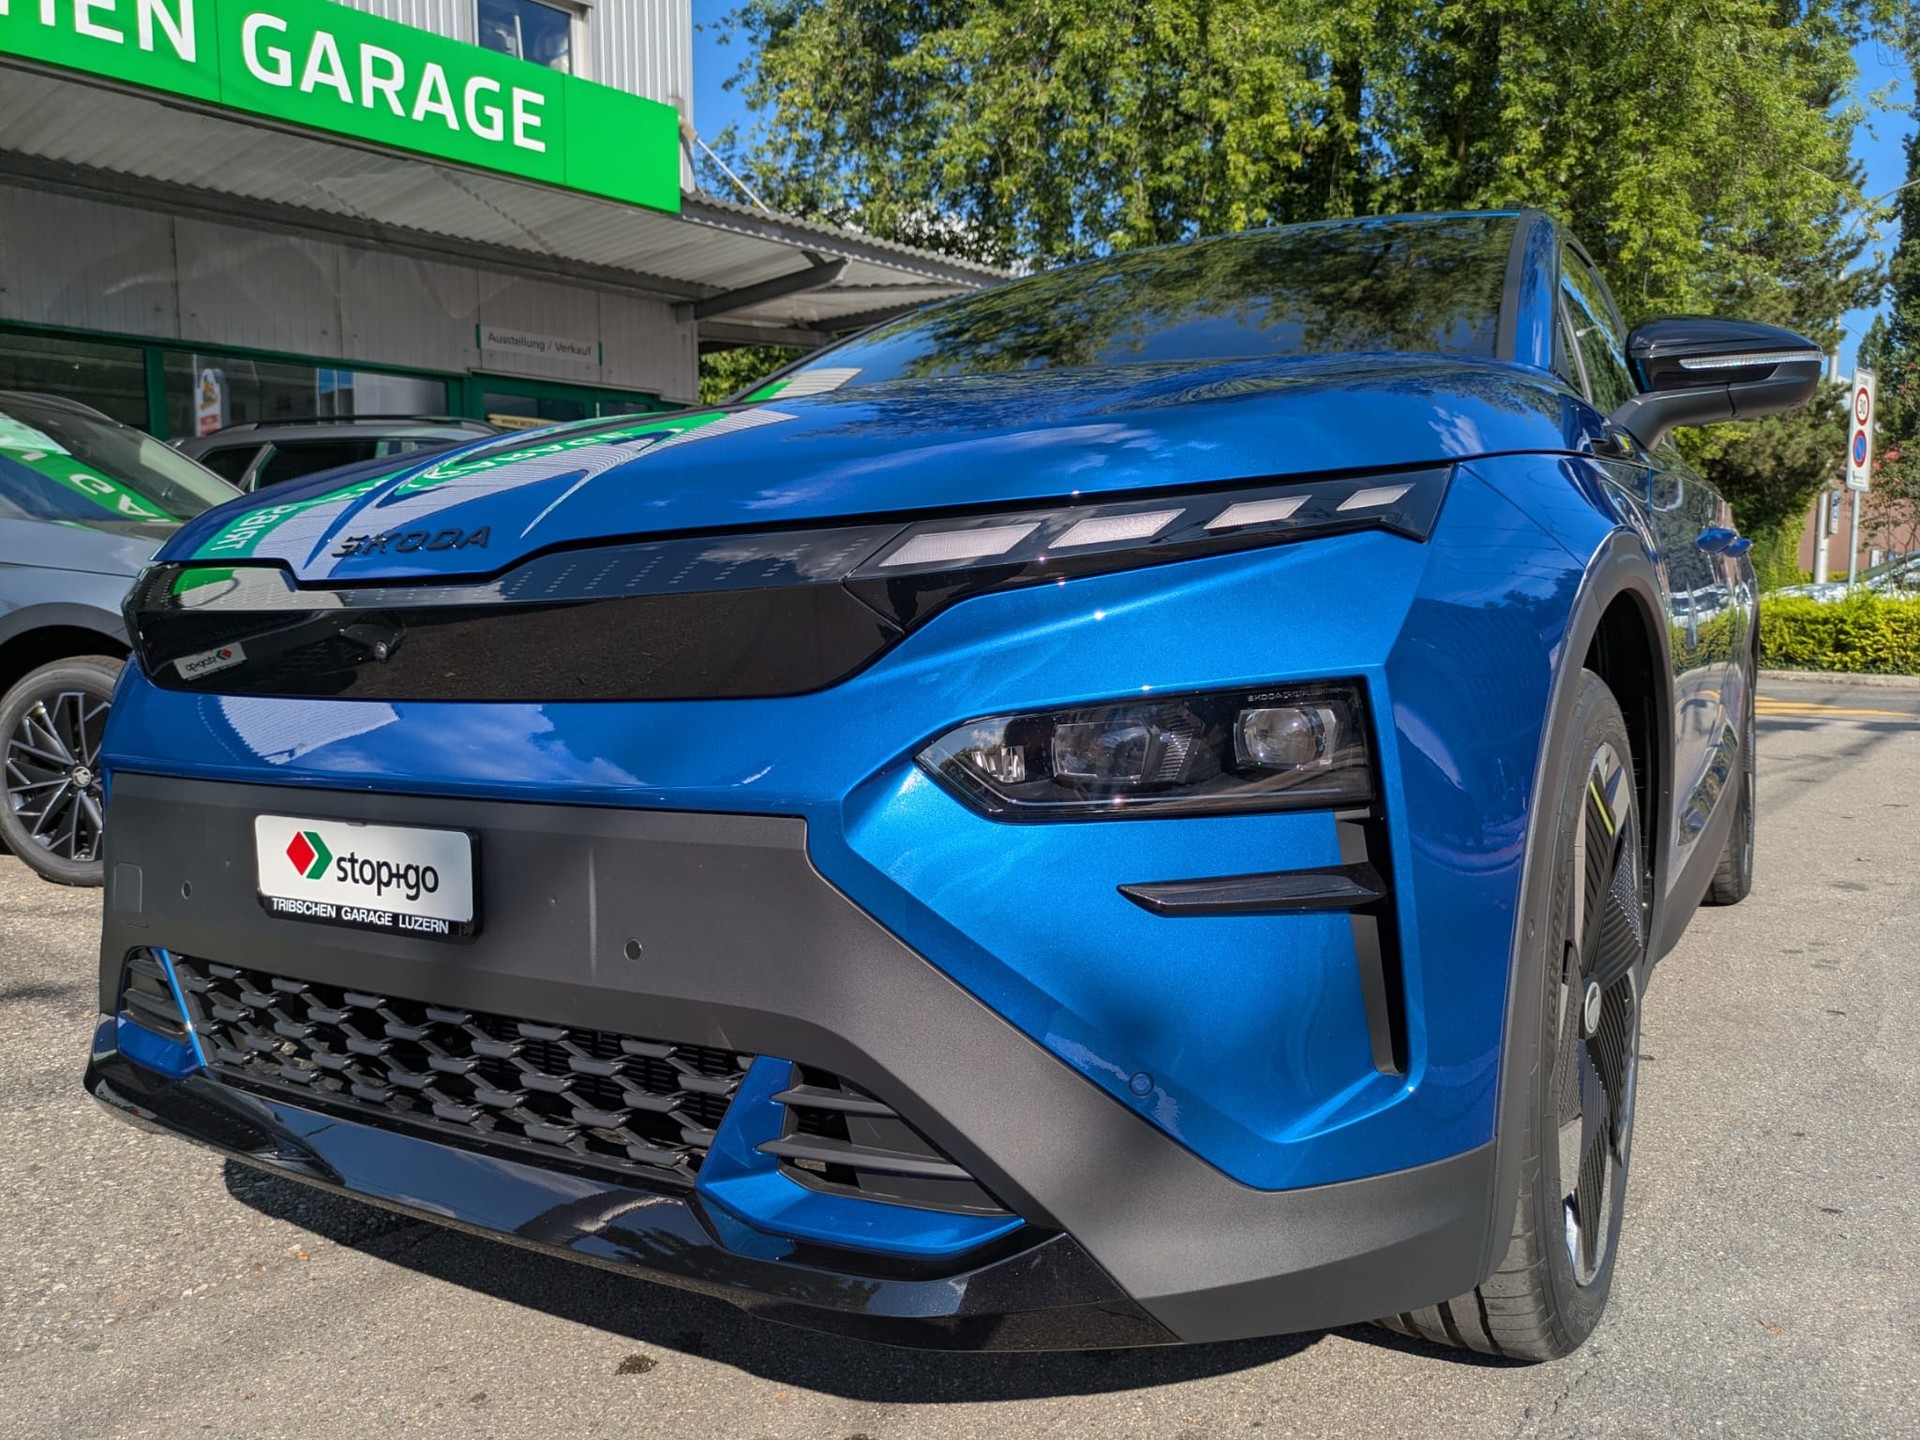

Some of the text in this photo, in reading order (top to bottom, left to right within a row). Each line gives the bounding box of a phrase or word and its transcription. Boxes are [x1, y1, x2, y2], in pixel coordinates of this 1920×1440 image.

[0, 0, 546, 153] EN GARAGE
[488, 332, 546, 352] Ausstellung
[555, 342, 591, 356] Verkauf
[1859, 399, 1866, 415] 30
[336, 851, 439, 901] stop+go
[271, 898, 449, 934] TRIBSCHEN GARAGE LUZERN
